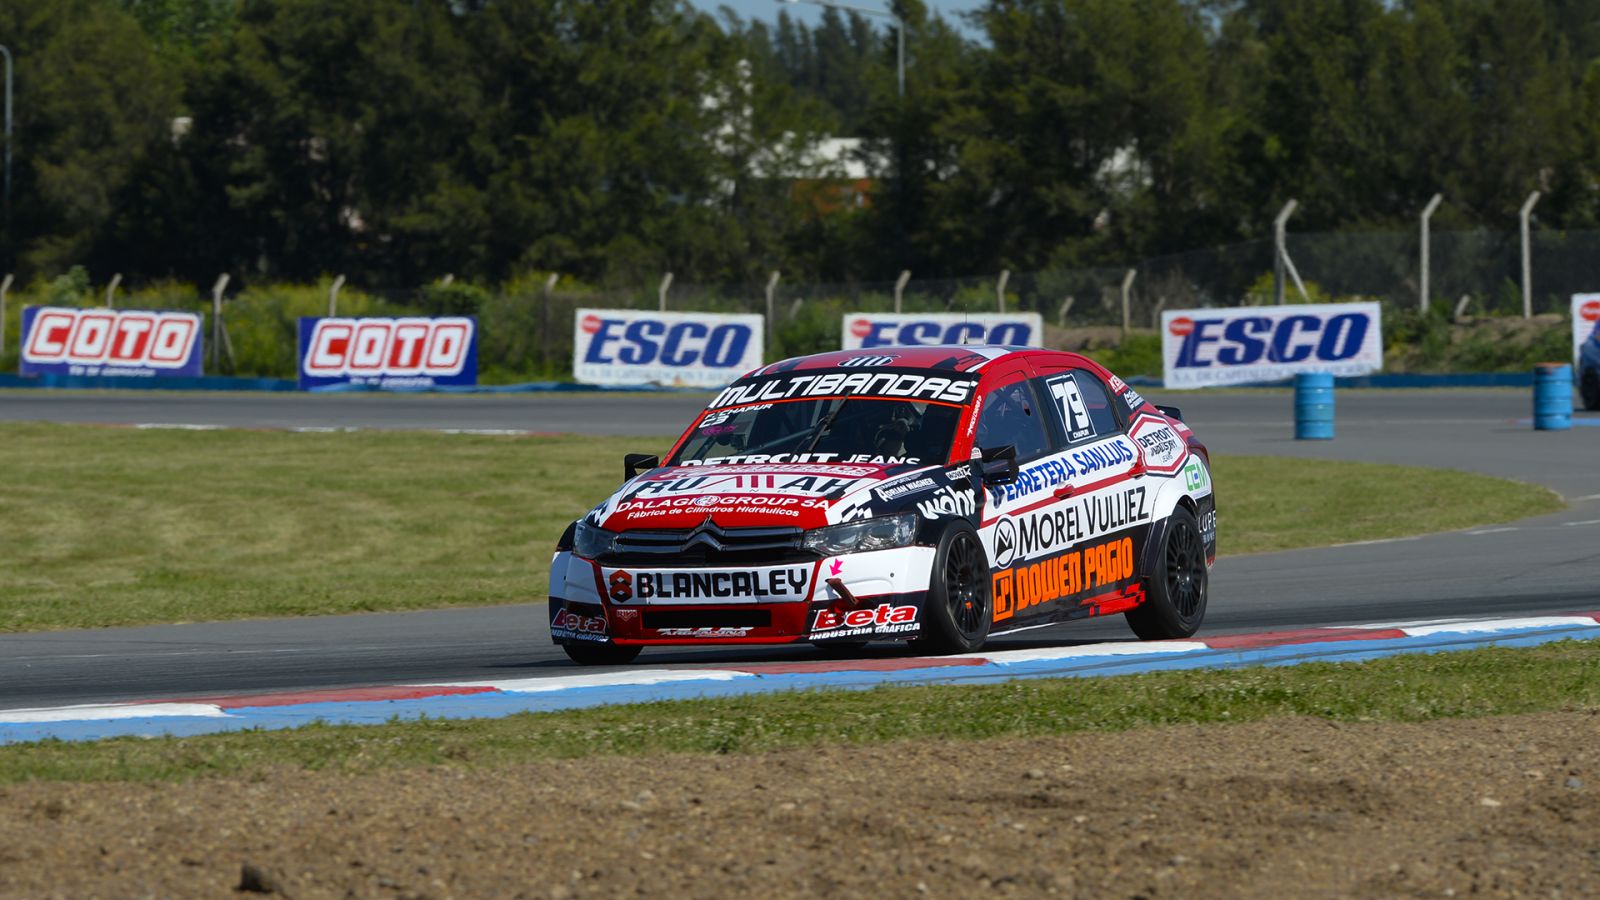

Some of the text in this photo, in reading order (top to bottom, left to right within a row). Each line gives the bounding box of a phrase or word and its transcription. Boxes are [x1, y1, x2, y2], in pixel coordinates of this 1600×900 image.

[27, 311, 197, 364] COTO
[307, 321, 470, 372] COTO
[583, 319, 753, 368] ESCO
[1173, 313, 1371, 368] ESCO
[709, 373, 975, 409] MULTIBANDAS
[1051, 380, 1090, 432] 79
[1137, 427, 1175, 448] DETROIT
[906, 477, 936, 492] WAGNER
[626, 505, 800, 520] Fábrica de Cilindros Hidráulicos
[719, 496, 799, 507] GROUP
[800, 499, 831, 510] SA
[1019, 486, 1150, 556] MOREL VULLIEZ
[636, 568, 808, 598] BLANCALEY
[1016, 536, 1134, 611] DOWEN PAGIO
[809, 626, 873, 640] INDUSTRIA
[811, 603, 918, 632] Beta
